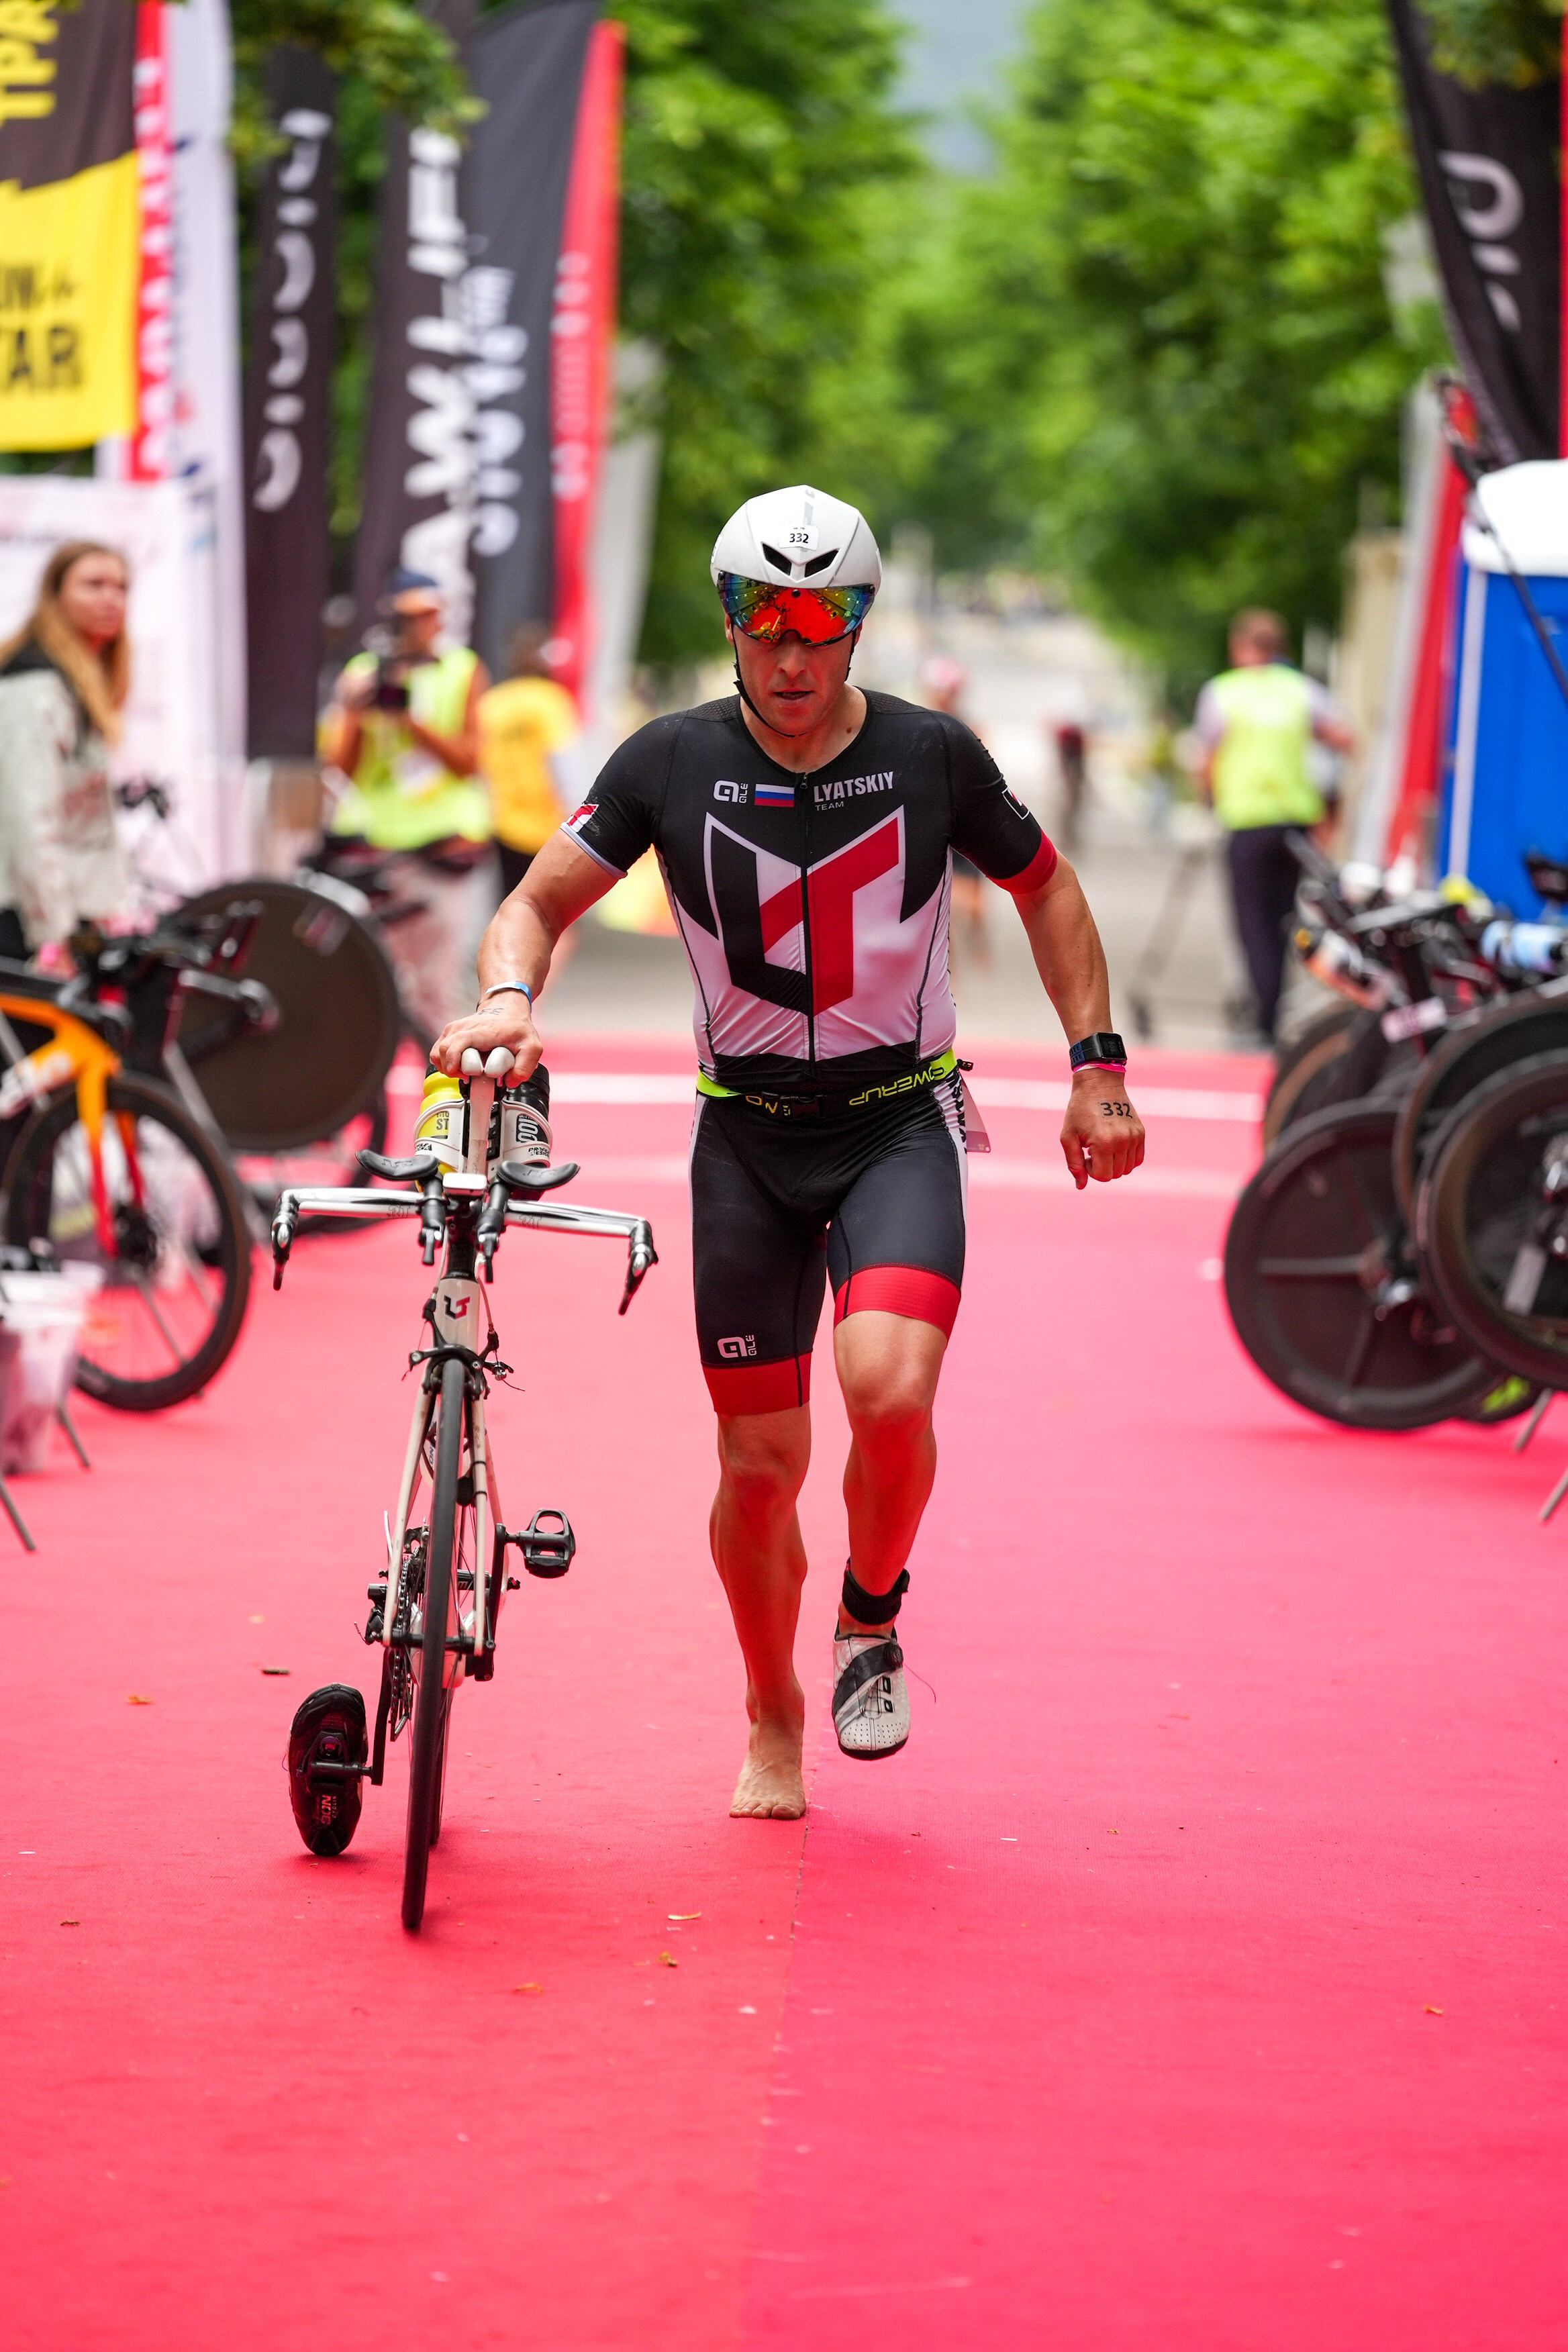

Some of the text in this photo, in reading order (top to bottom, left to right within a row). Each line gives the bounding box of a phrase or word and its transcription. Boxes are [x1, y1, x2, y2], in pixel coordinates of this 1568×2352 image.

[789, 532, 810, 544] 332
[814, 771, 893, 803] LYATSKIY
[815, 801, 844, 812] TEAM
[1100, 1101, 1133, 1119] 332
